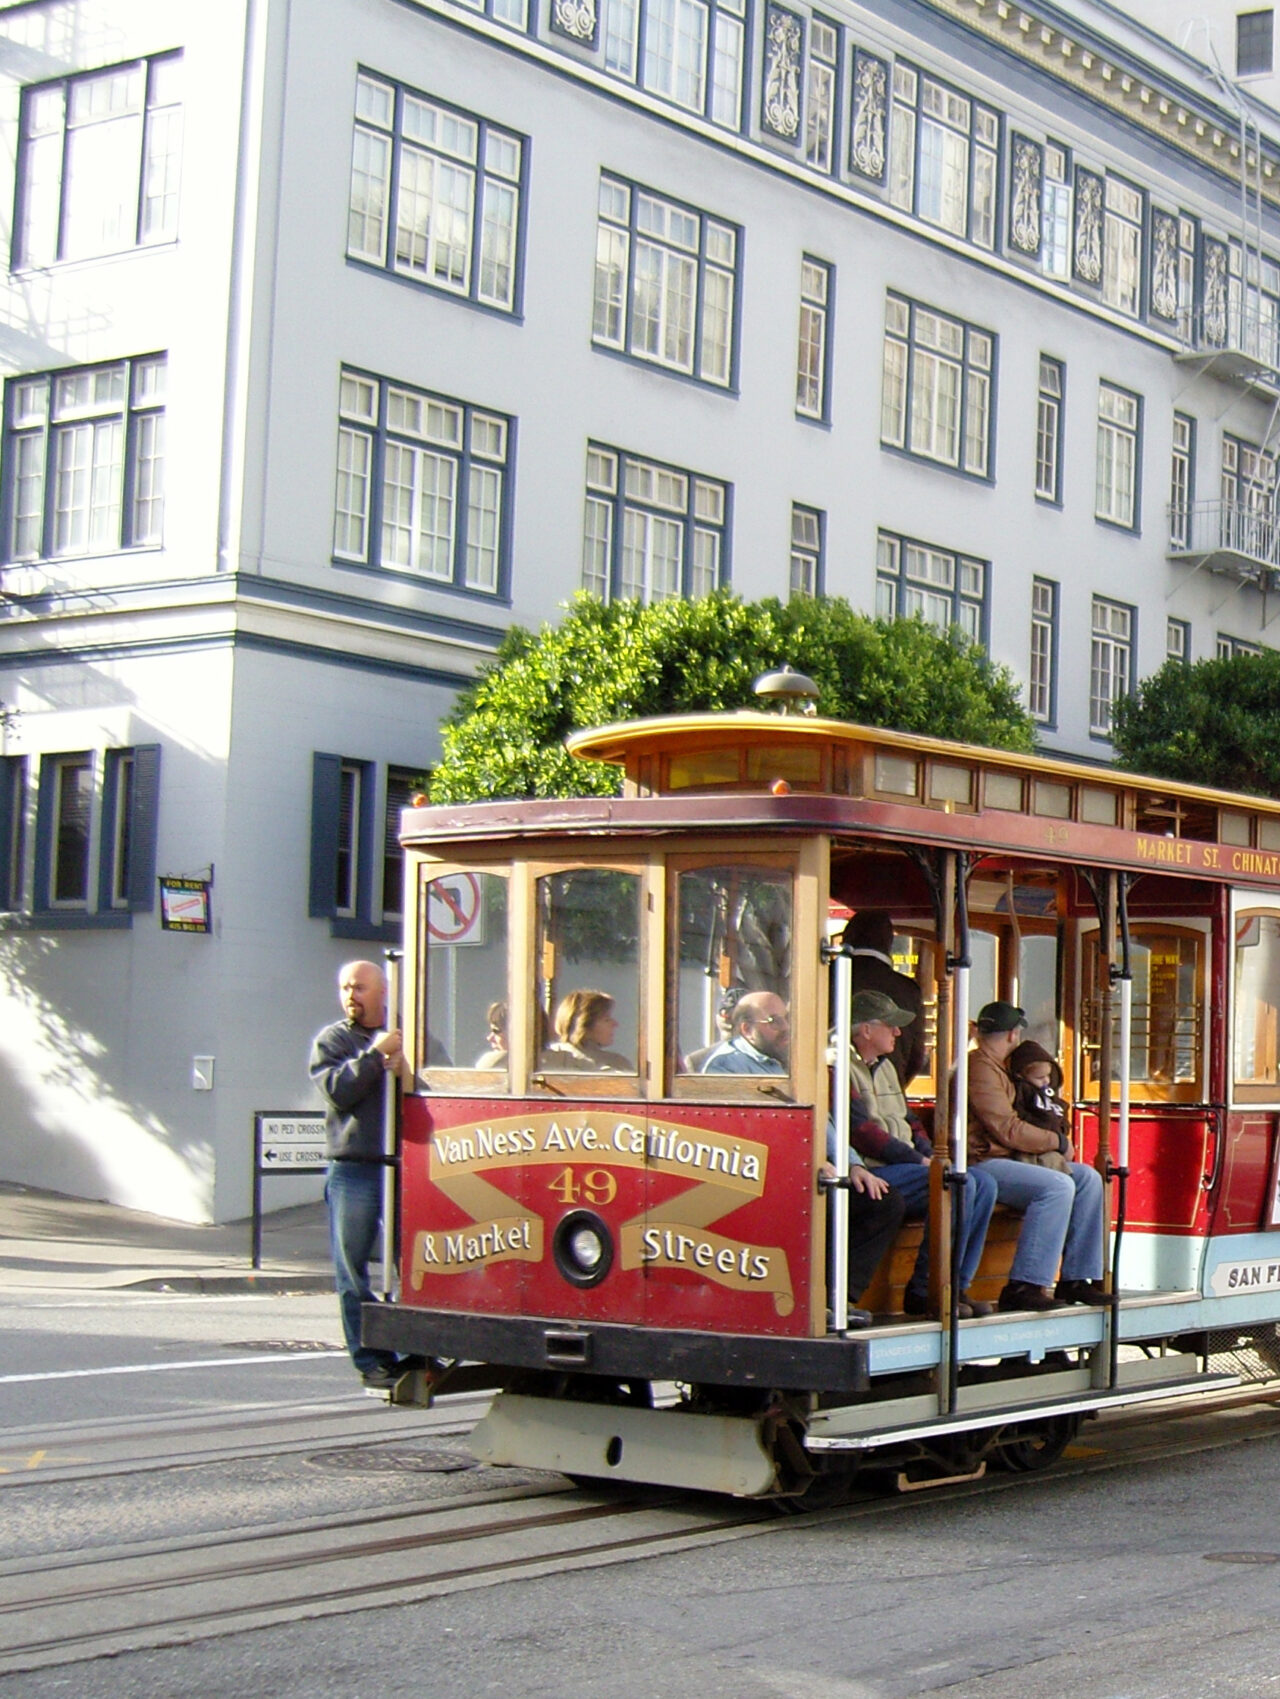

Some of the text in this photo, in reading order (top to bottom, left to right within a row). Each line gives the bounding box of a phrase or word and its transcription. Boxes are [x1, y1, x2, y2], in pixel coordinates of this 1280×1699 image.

[1136, 837, 1192, 865] MARKET
[166, 880, 203, 890] FOR RENT
[269, 1124, 278, 1134] NO
[281, 1124, 294, 1134] PED
[279, 1152, 292, 1161] USE
[434, 1135, 475, 1165] Van
[474, 1126, 536, 1159] Ness
[612, 1121, 760, 1181] California
[548, 1166, 618, 1206] 49
[424, 1220, 531, 1265] & Market
[642, 1228, 771, 1280] Streets
[1228, 1266, 1262, 1289] SAN
